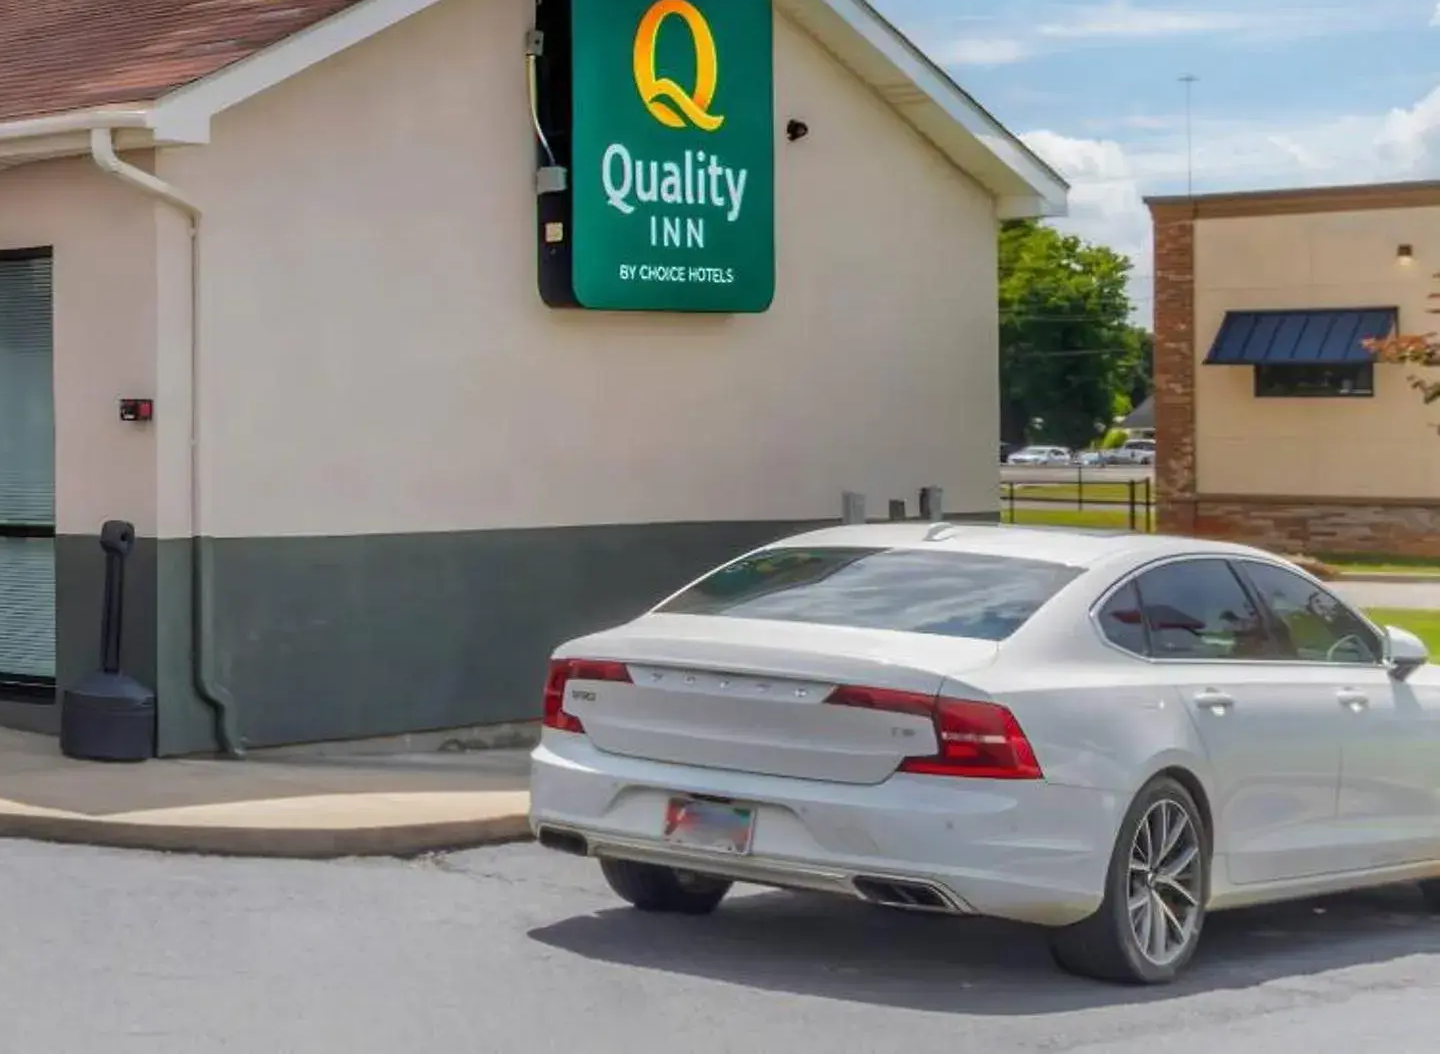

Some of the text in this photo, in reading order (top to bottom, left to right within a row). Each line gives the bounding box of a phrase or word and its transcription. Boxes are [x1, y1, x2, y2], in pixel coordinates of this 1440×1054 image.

[602, 143, 747, 222] Quality
[650, 215, 705, 249] INN
[620, 264, 734, 284] BY CHOICE HOTELS
